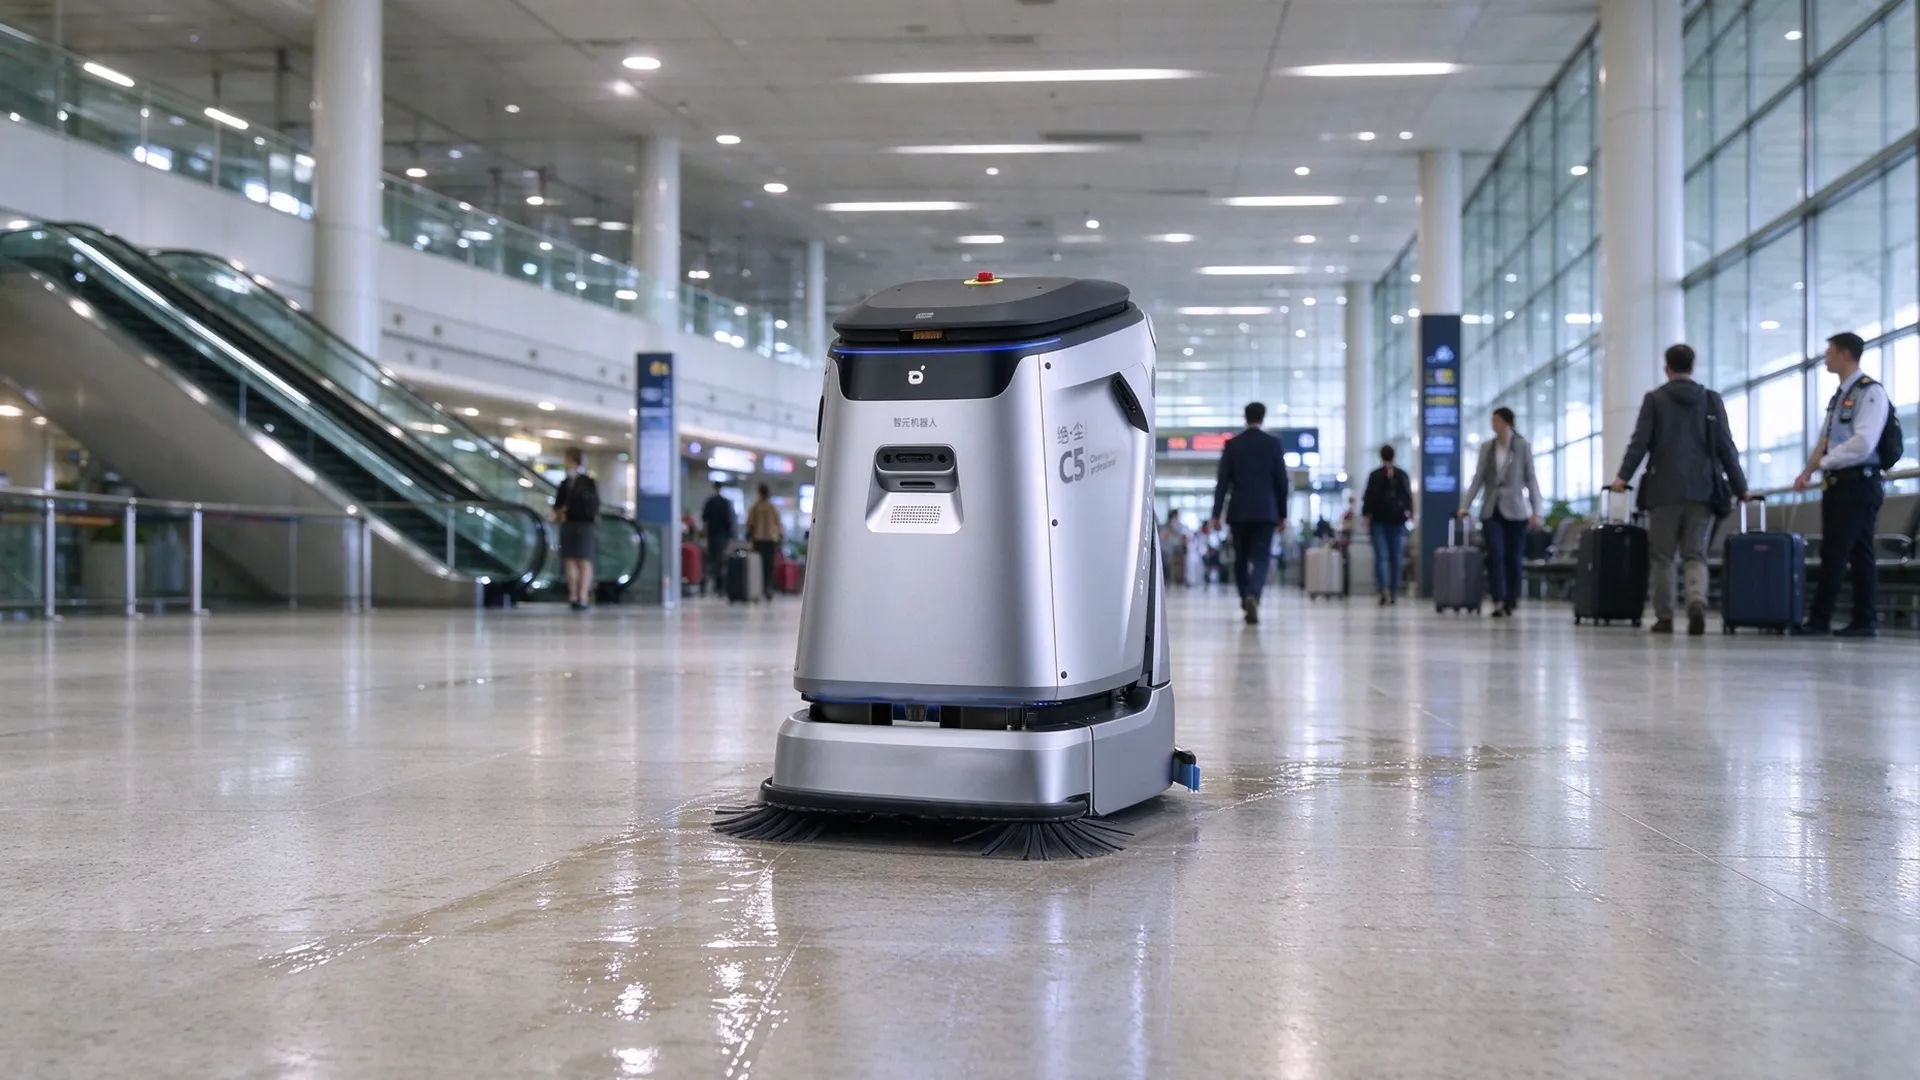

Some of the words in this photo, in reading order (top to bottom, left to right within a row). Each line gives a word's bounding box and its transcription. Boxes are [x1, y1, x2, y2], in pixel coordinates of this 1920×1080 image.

[893, 416, 938, 428] 智元机器人
[1059, 446, 1085, 484] C5
